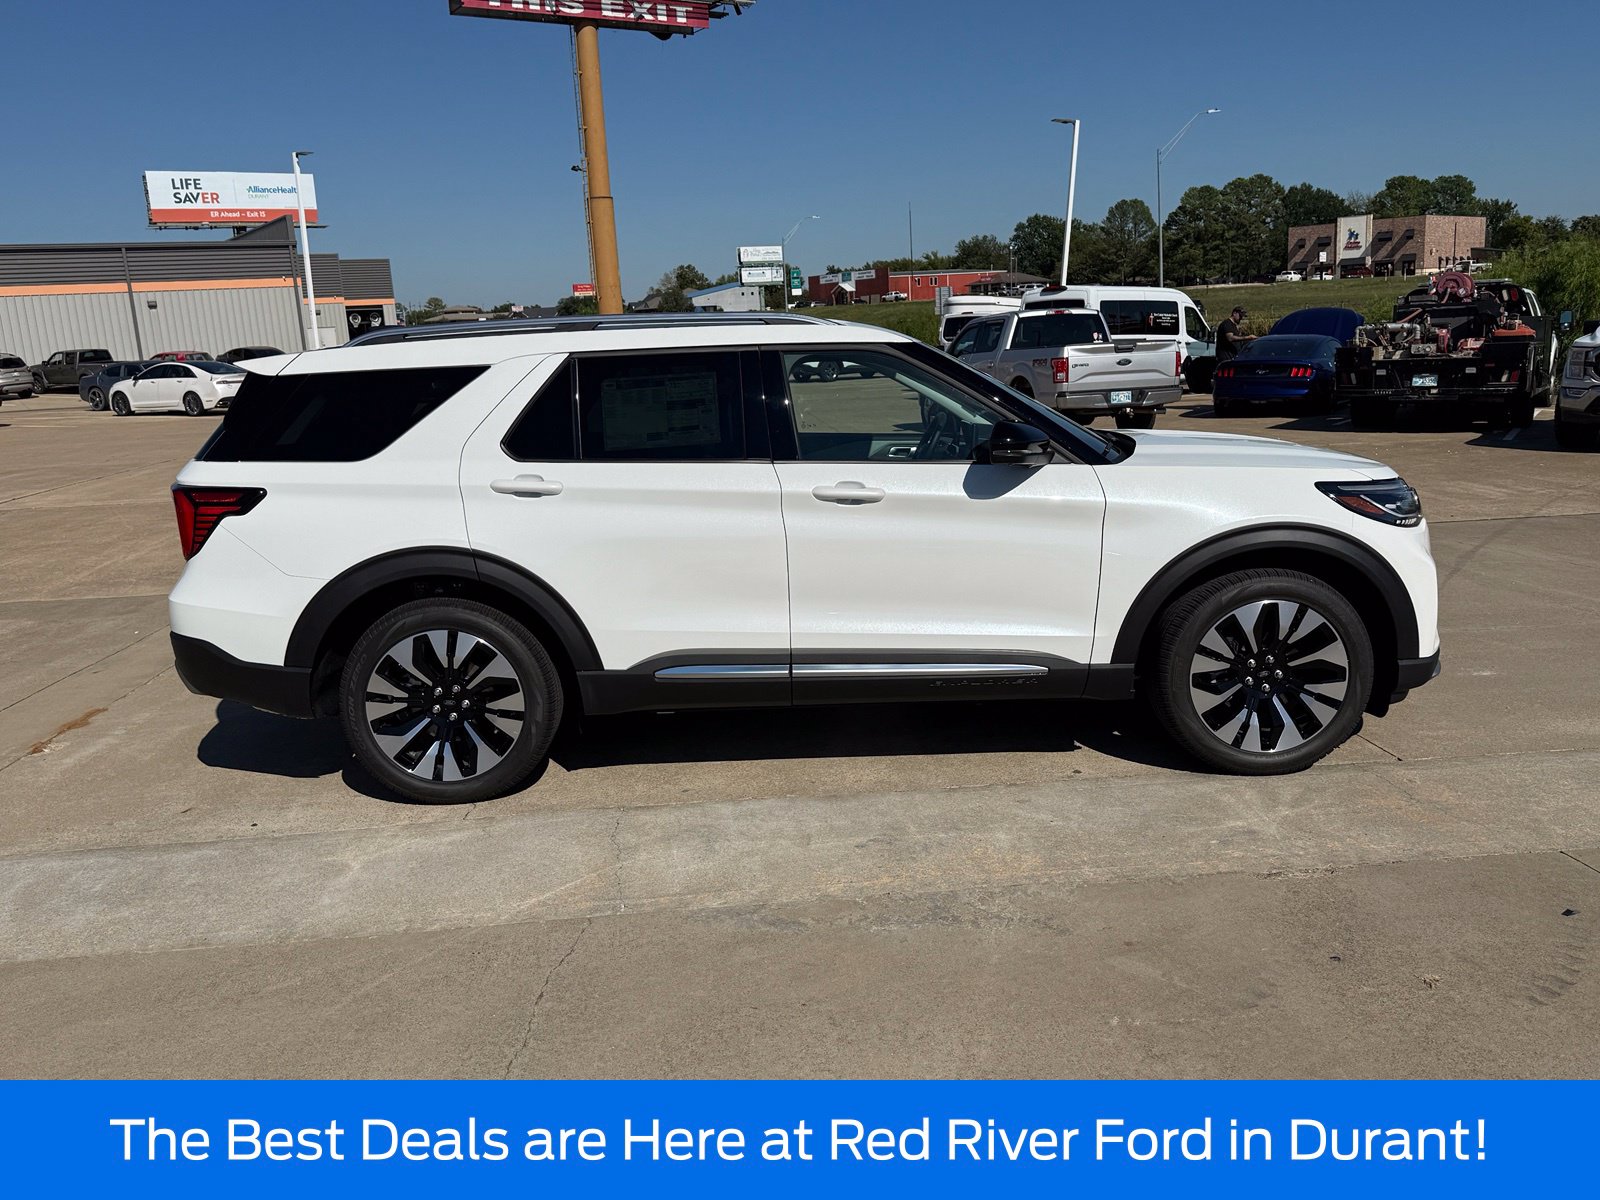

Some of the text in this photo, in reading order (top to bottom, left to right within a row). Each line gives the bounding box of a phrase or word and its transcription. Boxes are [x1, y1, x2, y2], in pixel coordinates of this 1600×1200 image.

[601, 0, 693, 23] EXIT
[171, 178, 202, 190] LIFE
[247, 185, 298, 194] AllianceHealt
[173, 192, 220, 204] SAVER
